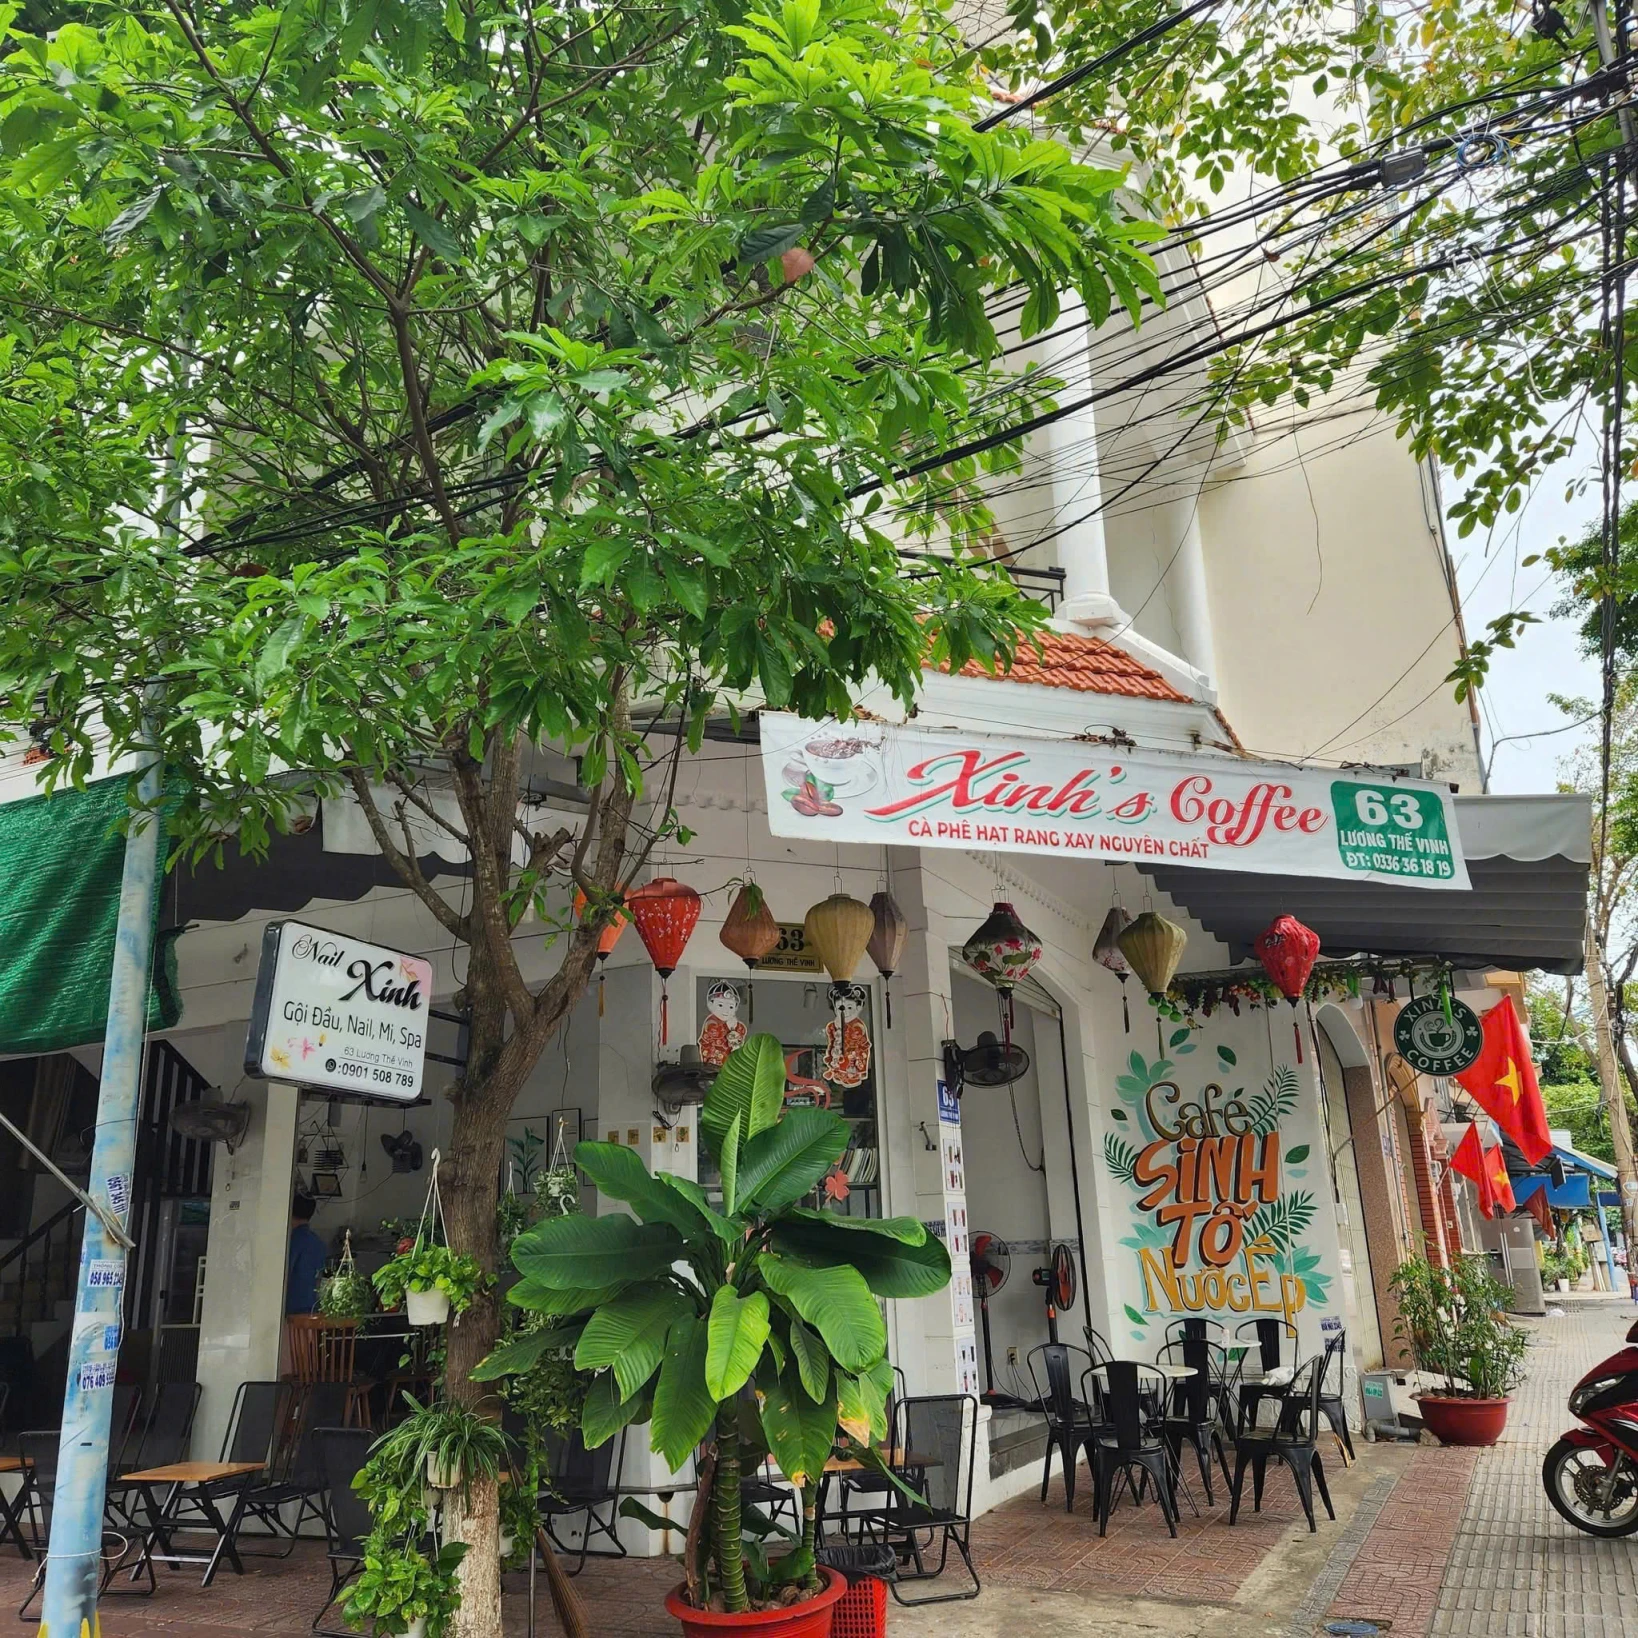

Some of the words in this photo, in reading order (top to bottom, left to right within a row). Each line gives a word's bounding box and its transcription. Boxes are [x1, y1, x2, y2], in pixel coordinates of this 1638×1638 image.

[863, 749, 1157, 825] Xinh's
[1170, 774, 1329, 847] Coffee
[1355, 789, 1424, 829] 63
[908, 816, 933, 837] CÀ
[937, 819, 972, 840] PHÊ
[976, 825, 1008, 845] HẠT
[1014, 828, 1060, 847] RANG
[1065, 832, 1095, 849] XAY
[1100, 834, 1164, 855] NGUYÊN
[1169, 837, 1209, 858] CHẤT
[1340, 829, 1387, 848] LƯƠNG
[1388, 832, 1413, 852] THẾ
[1415, 837, 1449, 855] VINH
[1346, 851, 1371, 867] ĐT:
[1373, 853, 1400, 872] 0336
[1402, 856, 1419, 874] 36
[1420, 859, 1435, 875] 18
[1436, 860, 1452, 876] 19
[292, 934, 345, 968] Nail
[775, 927, 805, 951] 63
[338, 959, 423, 1010] Xinh
[283, 1001, 308, 1027] Gội
[312, 1006, 343, 1033] Đầu,
[347, 1015, 375, 1040] Nail,
[379, 1021, 396, 1045] Mi,
[399, 1026, 422, 1050] Spa
[344, 1046, 354, 1057] 63
[1406, 1048, 1474, 1072] COFFEE
[372, 1068, 392, 1084] 508
[395, 1072, 414, 1088] 789
[1156, 1200, 1259, 1268] TỐ
[82, 1375, 94, 1390] 076
